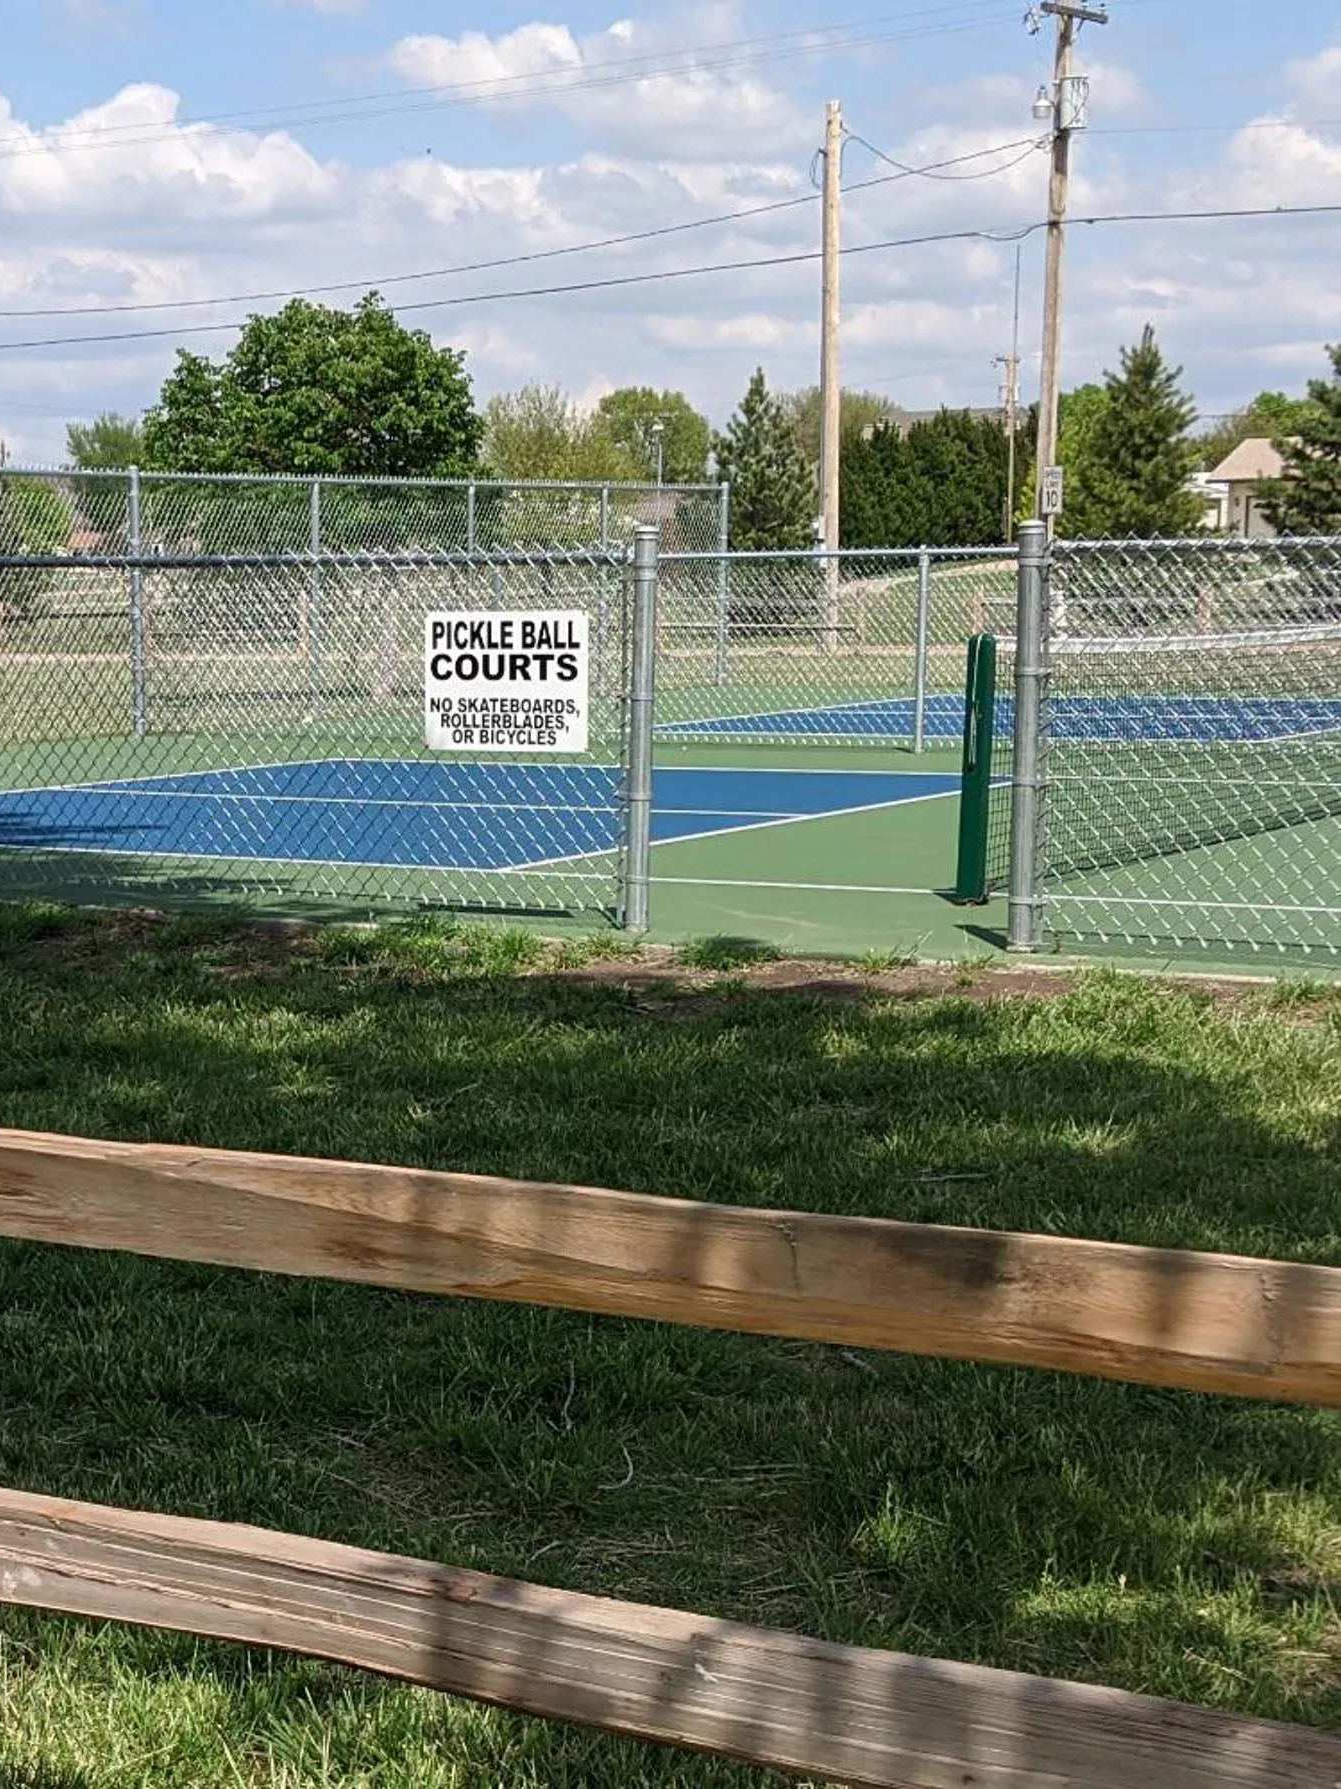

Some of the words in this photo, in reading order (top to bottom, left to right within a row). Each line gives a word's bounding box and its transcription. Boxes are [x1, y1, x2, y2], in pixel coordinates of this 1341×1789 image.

[1046, 490, 1059, 507] 10
[431, 620, 514, 650] PICKLE
[521, 620, 581, 650] BALL
[430, 653, 578, 681] COURTS
[430, 697, 453, 713] NO
[457, 697, 580, 718] SKATEBOARDS,
[441, 713, 569, 733] ROLLERBLADES,
[452, 729, 474, 744] OR
[479, 729, 557, 746] BICYCLES
